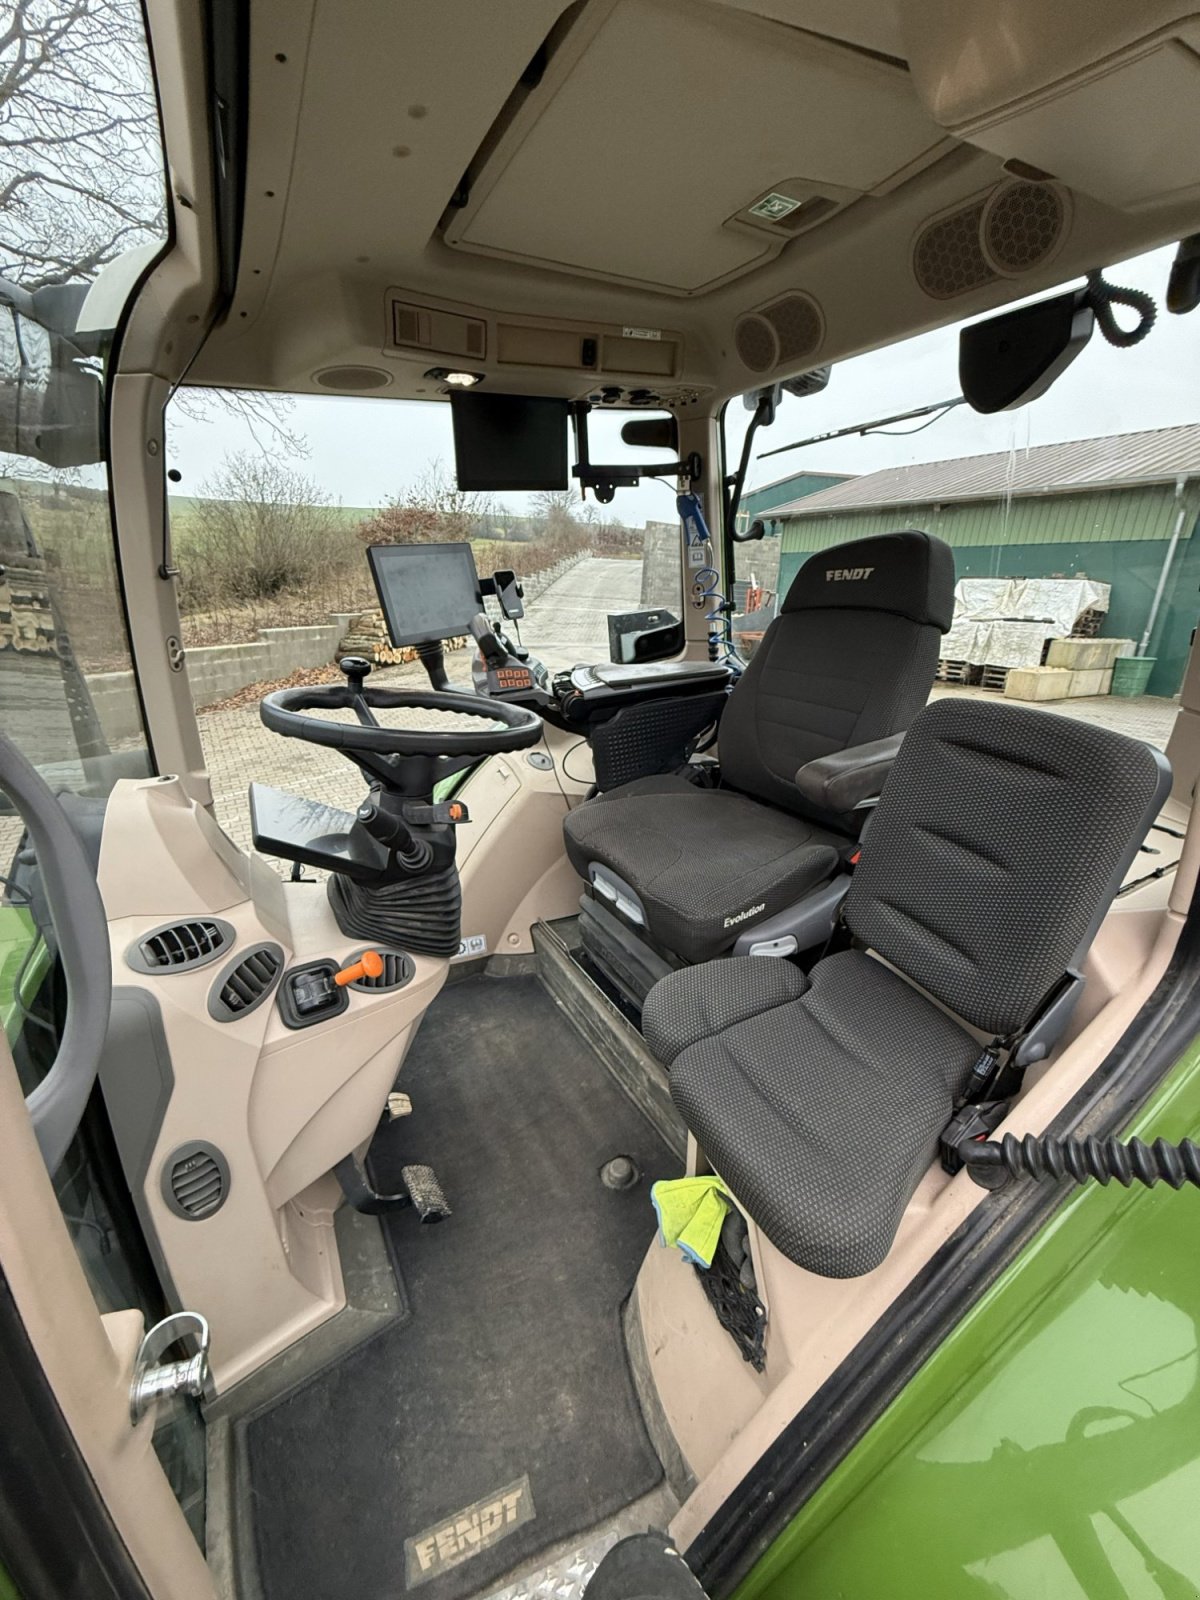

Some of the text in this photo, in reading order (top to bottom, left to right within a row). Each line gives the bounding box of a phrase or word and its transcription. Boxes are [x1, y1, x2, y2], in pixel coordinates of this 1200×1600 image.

[825, 567, 875, 582] FENDT
[723, 903, 766, 928] Evolution
[415, 1487, 523, 1572] FENDT
